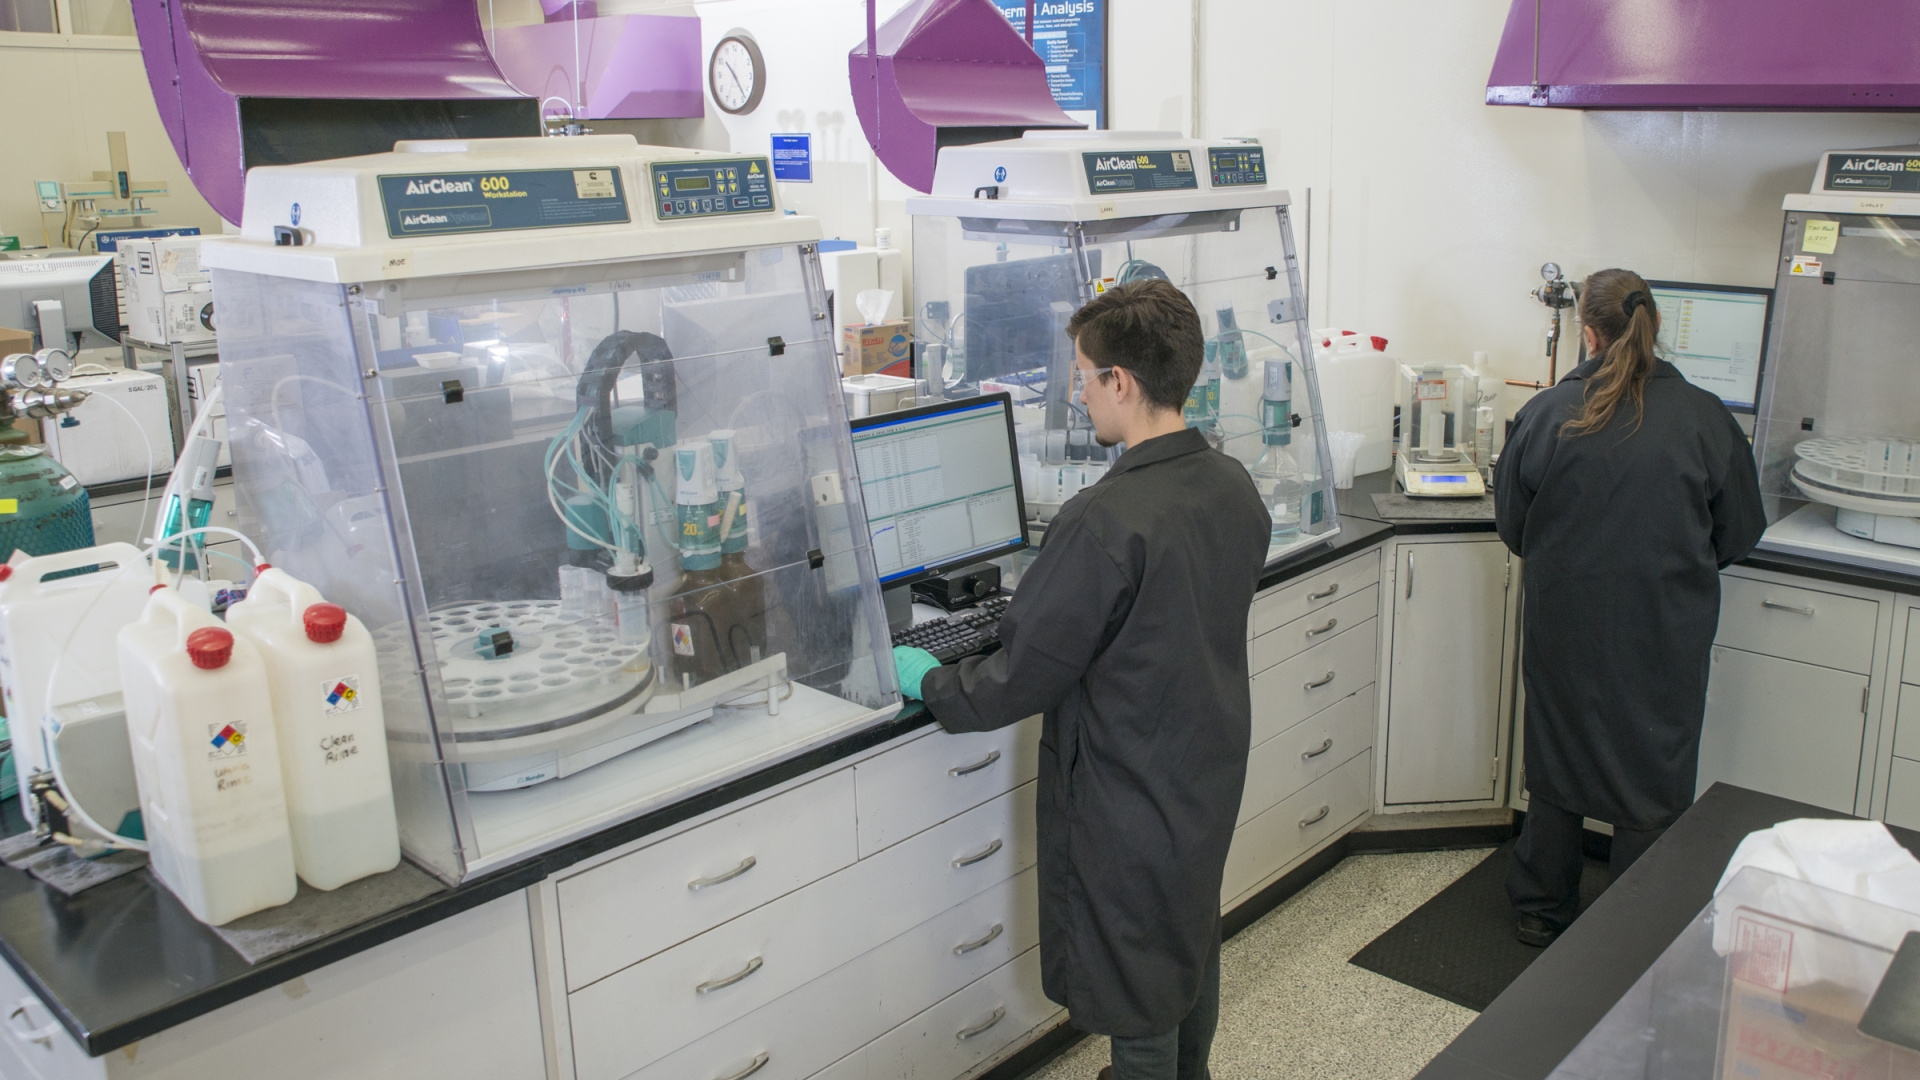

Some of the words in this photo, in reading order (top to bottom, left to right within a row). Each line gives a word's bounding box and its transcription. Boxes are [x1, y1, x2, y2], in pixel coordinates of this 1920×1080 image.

[1041, 0, 1094, 17] Analysis
[1096, 156, 1137, 171] AirClean
[1137, 156, 1149, 164] 600
[1841, 158, 1904, 171] AirClean
[406, 177, 474, 196] AirClean
[480, 176, 510, 191] 600
[483, 190, 528, 199] Workstation
[404, 214, 447, 226] AirClean
[389, 258, 406, 267] MOE
[683, 522, 697, 536] 20
[320, 733, 355, 751] Clean
[326, 746, 359, 765] Rinse
[217, 776, 253, 792] Rinse
